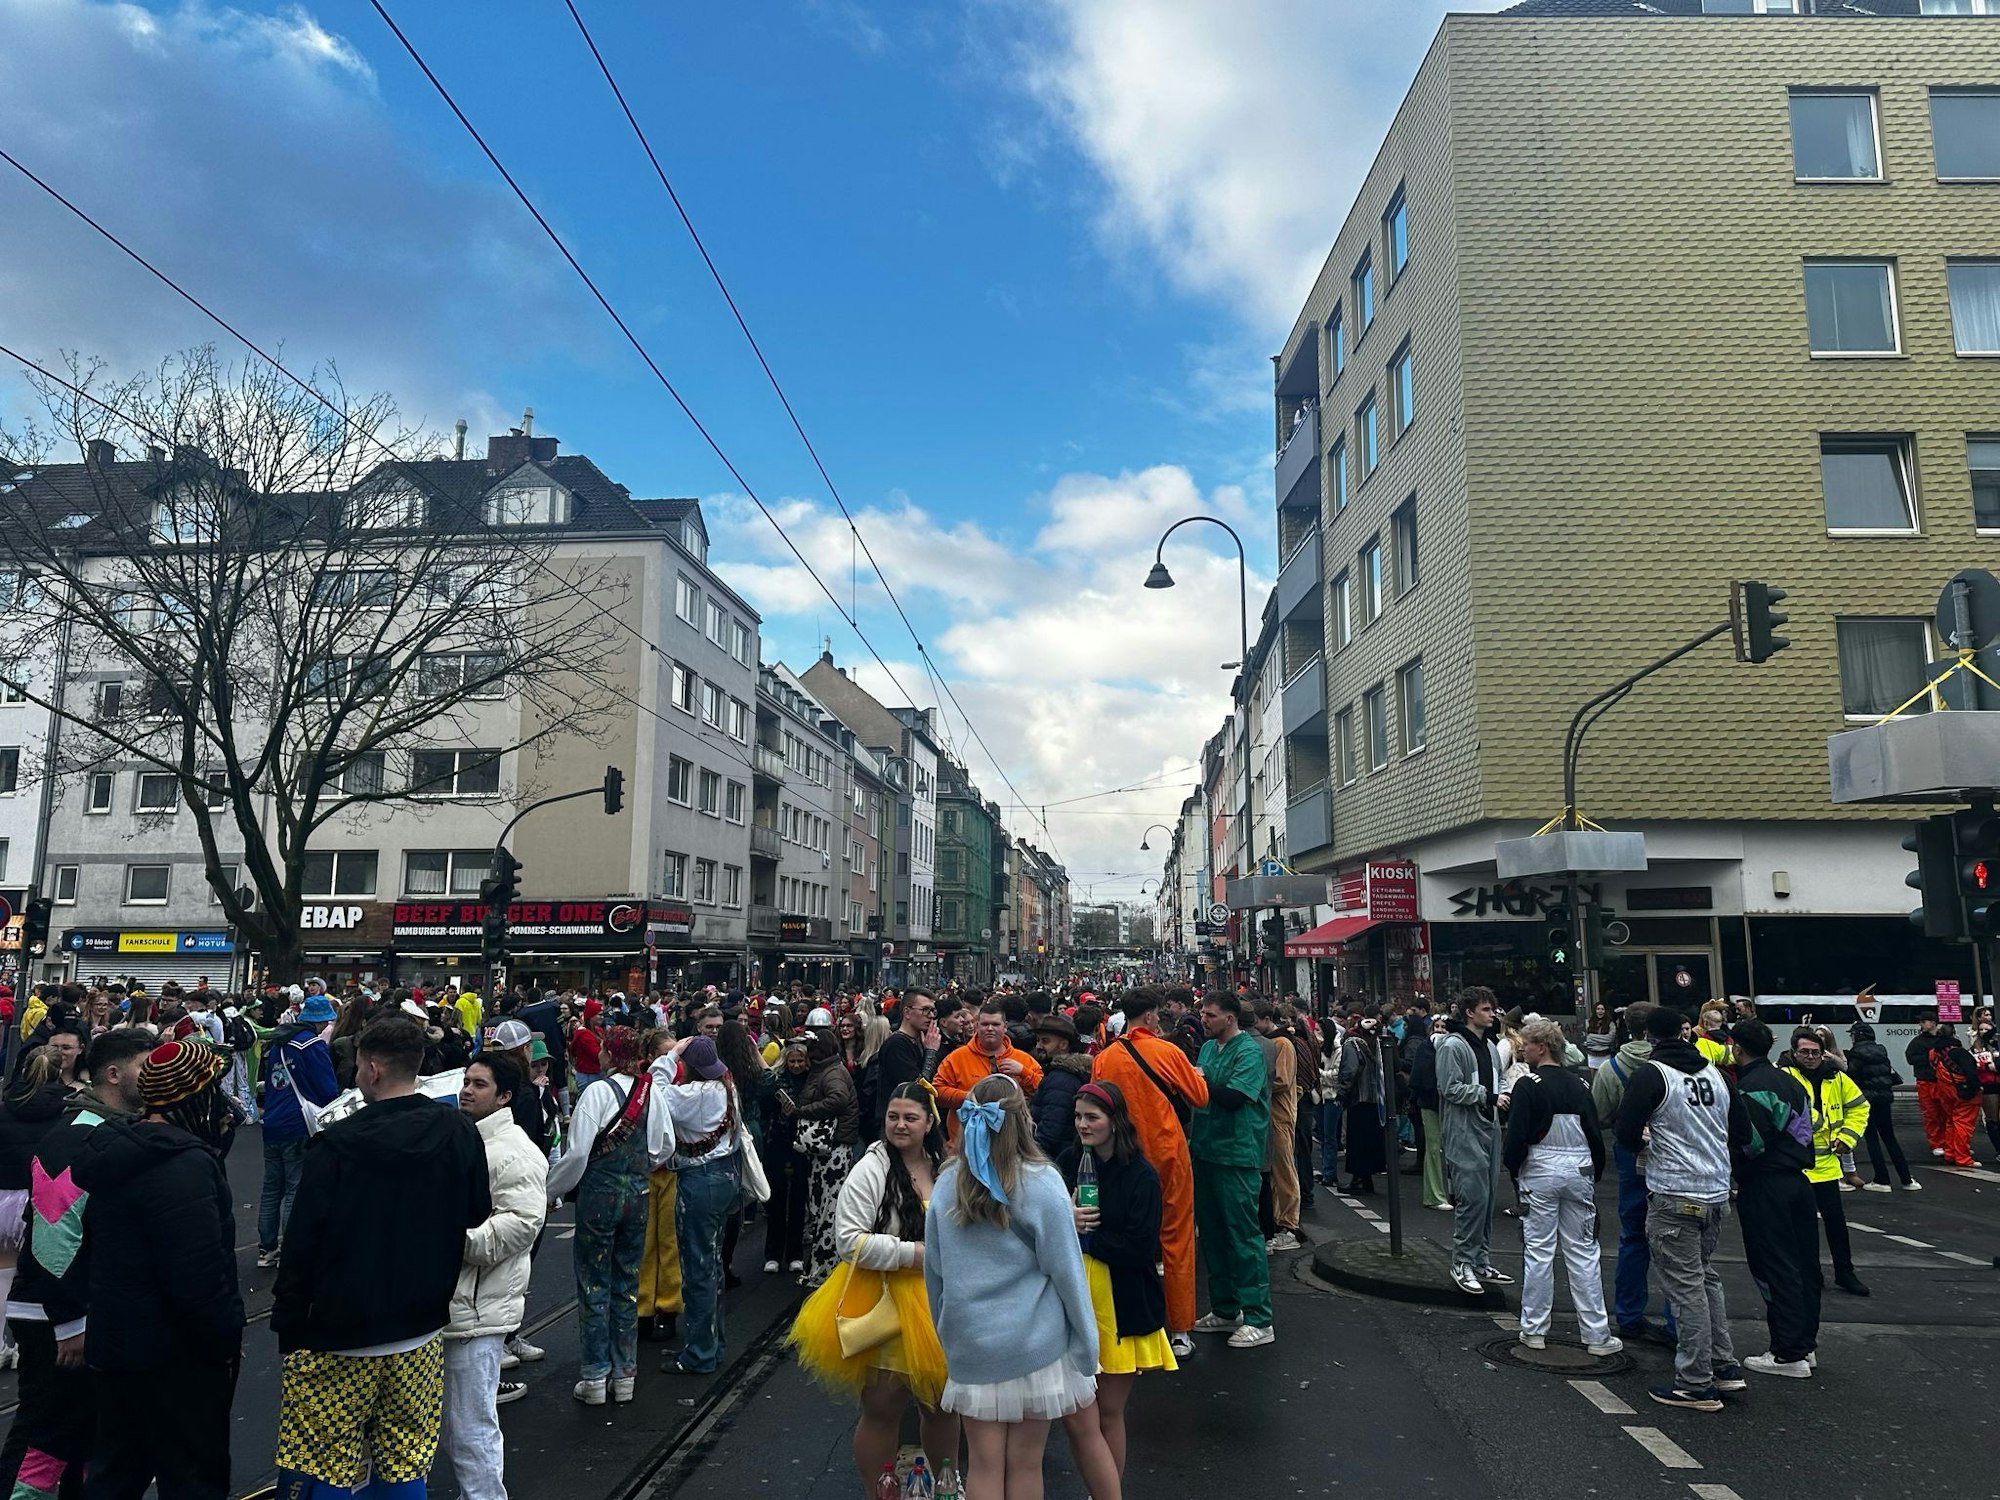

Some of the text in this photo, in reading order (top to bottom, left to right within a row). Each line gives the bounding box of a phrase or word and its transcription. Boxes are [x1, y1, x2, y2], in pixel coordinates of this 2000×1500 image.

[1371, 867, 1415, 879] KIOSK
[300, 906, 363, 928] EBAP
[395, 903, 606, 923] BEEF BUGER ONE
[85, 938, 114, 946] 50 Meter
[125, 938, 170, 946] FAHRSCHULE
[750, 999, 759, 1010] A
[1683, 1077, 1715, 1107] 38
